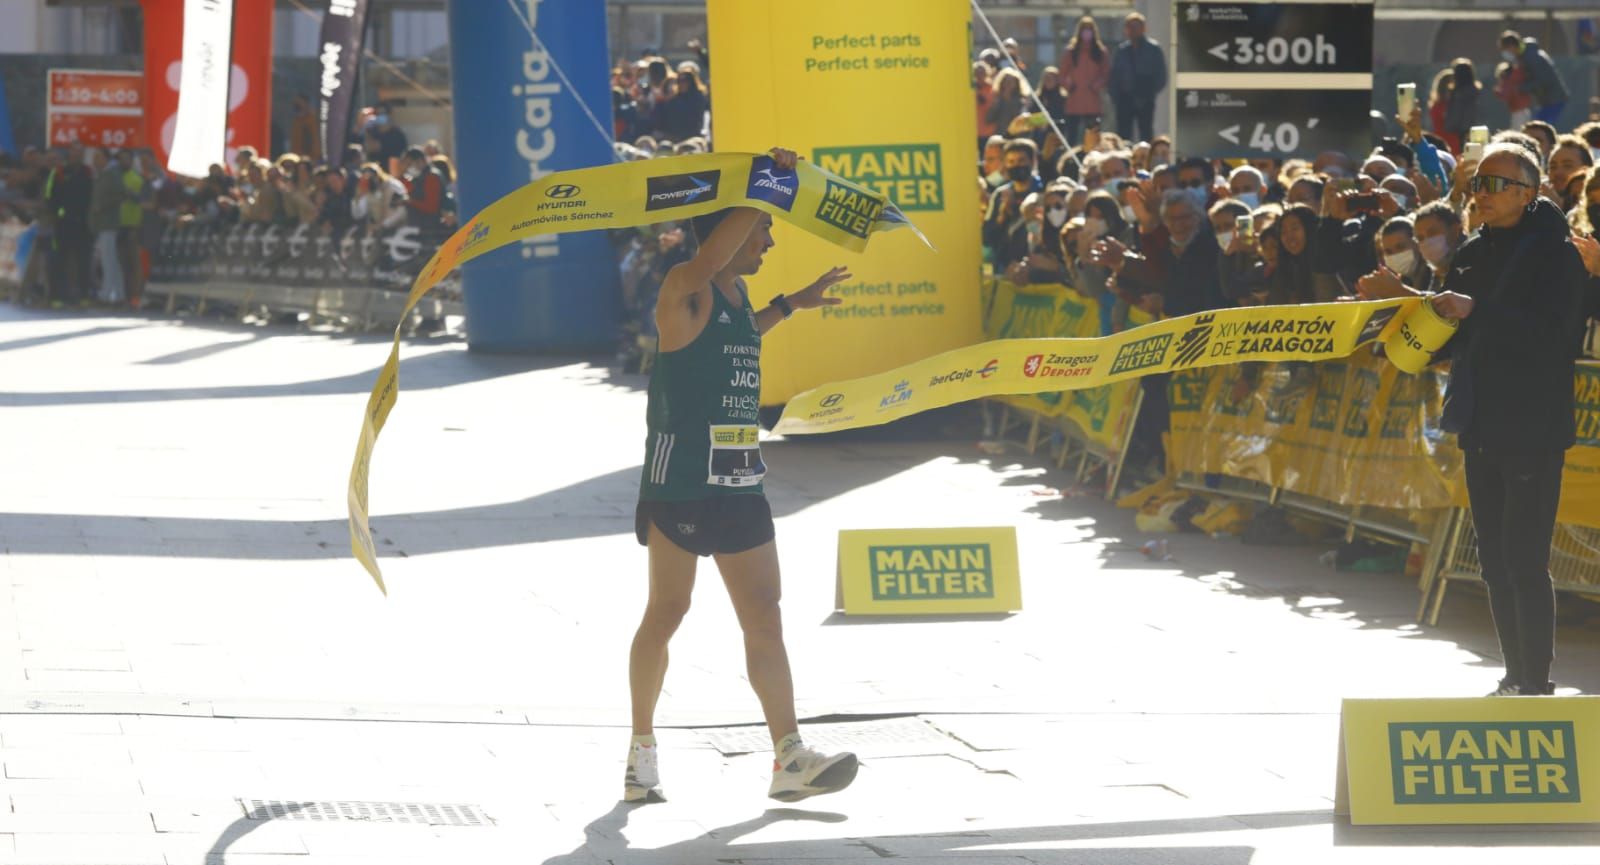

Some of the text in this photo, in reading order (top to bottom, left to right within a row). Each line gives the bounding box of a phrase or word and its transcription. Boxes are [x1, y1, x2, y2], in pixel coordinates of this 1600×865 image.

[812, 34, 921, 50] Perfect parts
[805, 54, 929, 72] Perfect service
[820, 150, 937, 178] MANN
[537, 200, 586, 211] HYUNDAI
[510, 210, 614, 233] Automóviles Sánchez
[829, 280, 937, 297] Perfect parts
[821, 302, 945, 319] Perfect service
[1216, 316, 1336, 339] XIV MARATÓN
[1119, 336, 1168, 359] MANN
[1210, 337, 1335, 357] DE ZARAGOZA
[1046, 353, 1099, 368] Zaragoza
[1112, 350, 1162, 373] FILTER
[929, 368, 973, 387] iberCaja
[879, 389, 913, 408] KLM
[743, 451, 750, 468] 1
[876, 549, 985, 571] MANN
[878, 571, 987, 595] FILTER
[1400, 729, 1566, 760] MANN
[1402, 763, 1570, 795] FILTER
